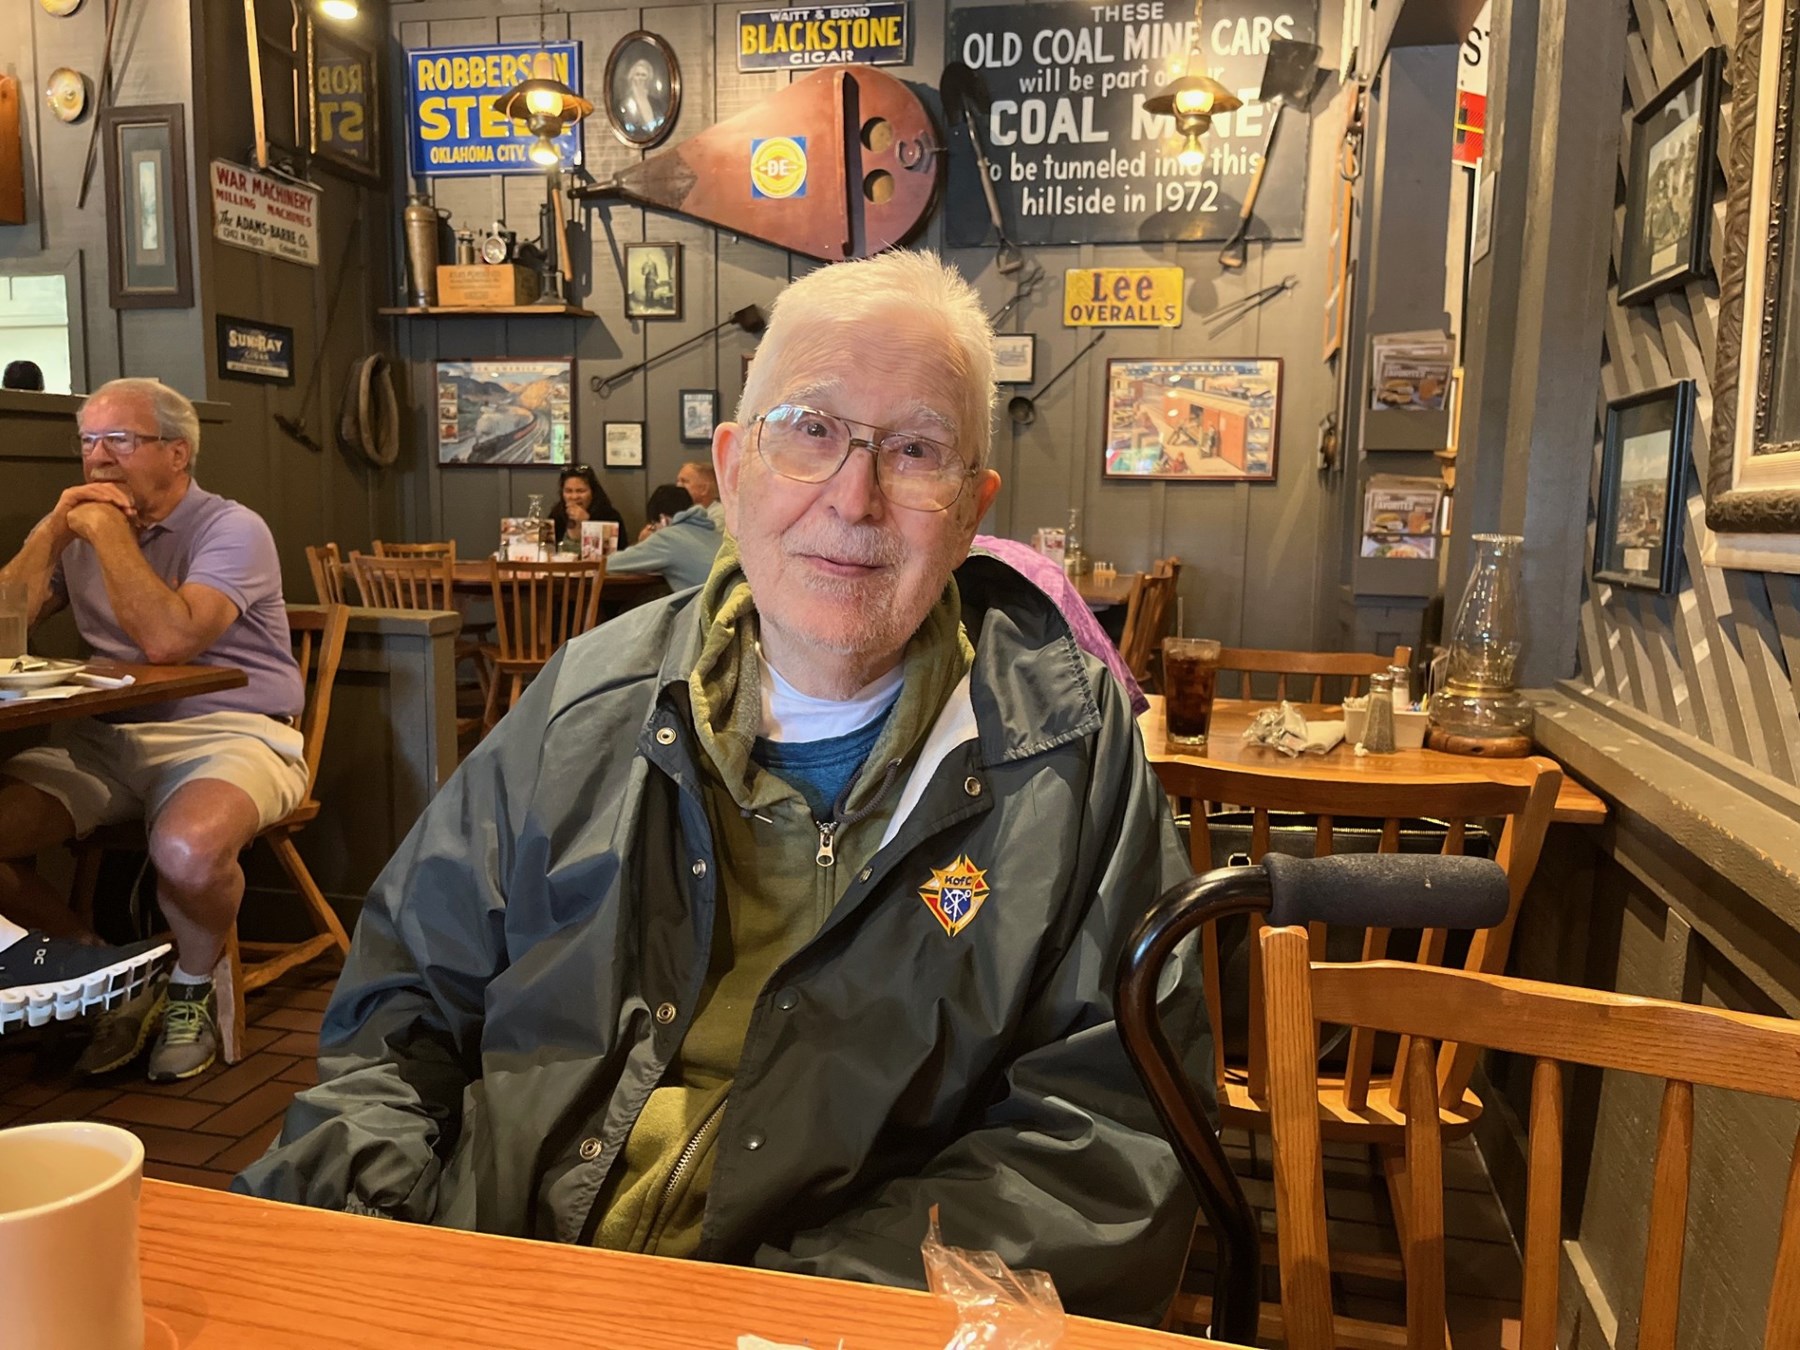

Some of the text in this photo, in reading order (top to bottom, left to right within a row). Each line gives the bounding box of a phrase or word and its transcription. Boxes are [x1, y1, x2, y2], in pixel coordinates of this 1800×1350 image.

[770, 7, 870, 22] WAITT & BOND
[1091, 2, 1165, 23] THESE
[741, 15, 902, 56] BLACKSTONE
[963, 14, 1294, 69] OLD COAL MINE CARS
[417, 52, 569, 91] ROBBERSN
[789, 49, 855, 64] CIGAR
[1019, 67, 1060, 93] will
[1069, 66, 1095, 91] be
[1102, 63, 1149, 97] part
[990, 86, 1263, 146] COAL MNE
[430, 144, 495, 164] OKLAHOMA
[767, 159, 789, 177] DE
[1010, 151, 1038, 182] be
[1043, 147, 1146, 181] tunneled
[1154, 148, 1203, 177] ino
[1210, 142, 1261, 176] this
[216, 166, 313, 212] WAR MACHINERY
[1022, 179, 1219, 216] hillside in 1972
[215, 188, 312, 228] MILLING MACHINES
[219, 209, 233, 227] The
[1091, 272, 1153, 302] Lee
[1071, 304, 1176, 321] OVERALLS
